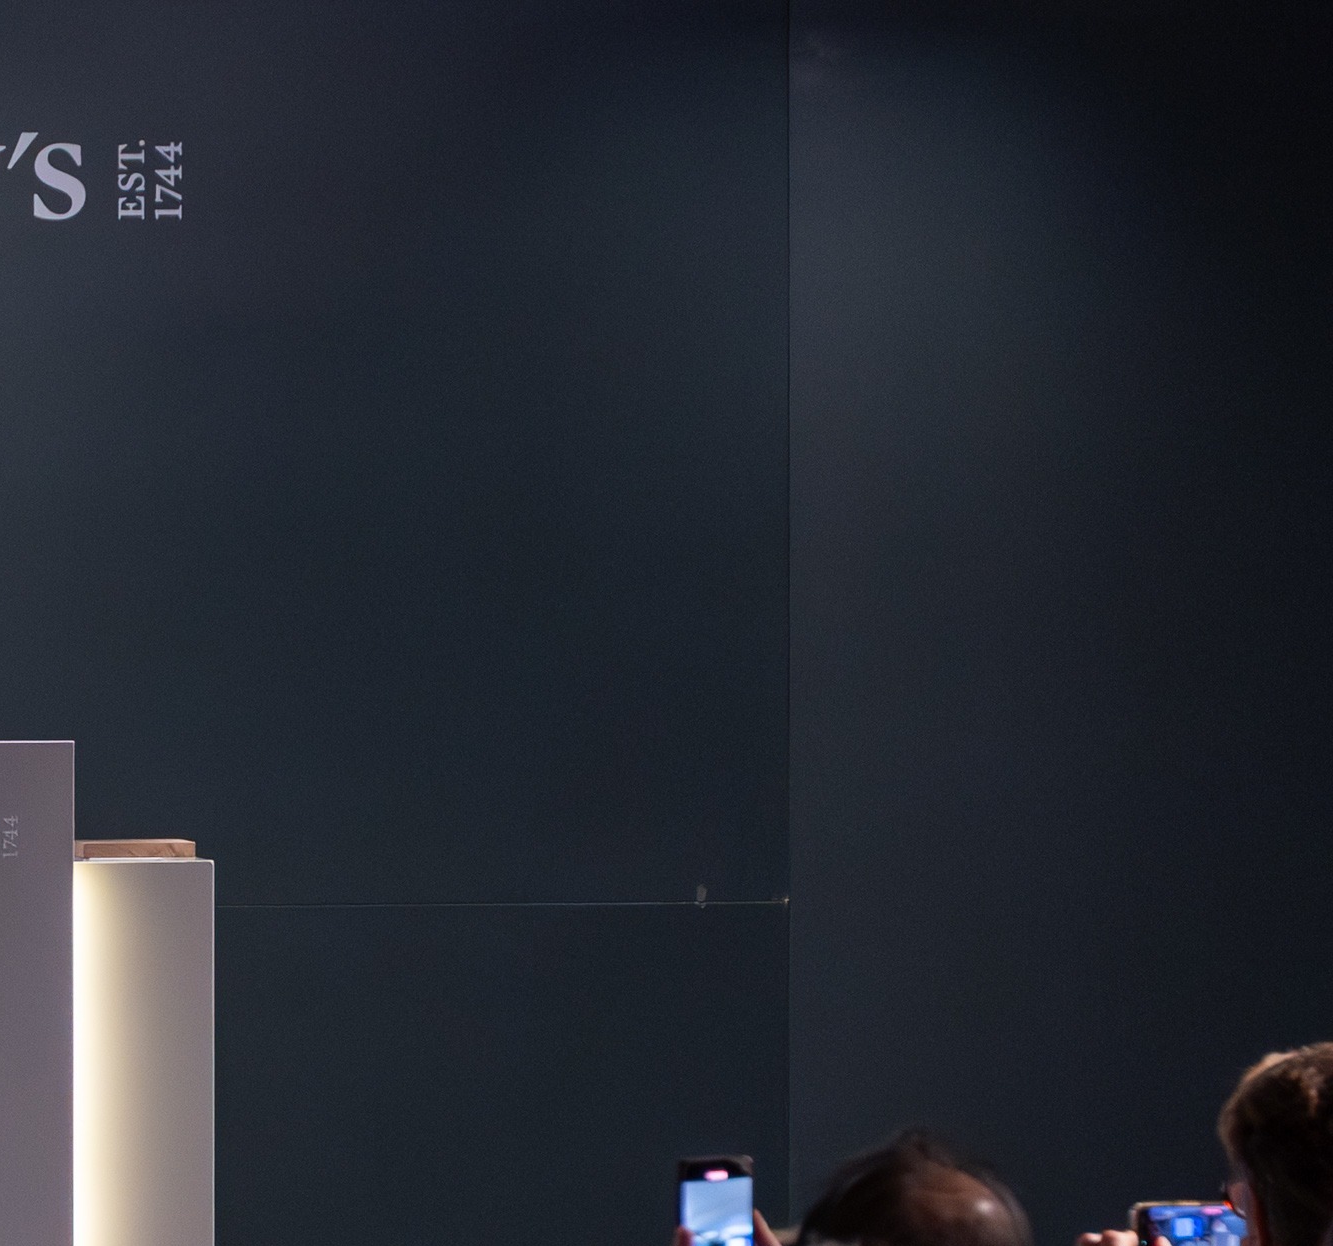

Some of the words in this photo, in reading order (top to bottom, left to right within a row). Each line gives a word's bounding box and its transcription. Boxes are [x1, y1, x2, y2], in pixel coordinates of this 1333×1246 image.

[118, 140, 145, 219] EST.
[155, 142, 182, 219] 1744
[2, 815, 19, 858] 1744
